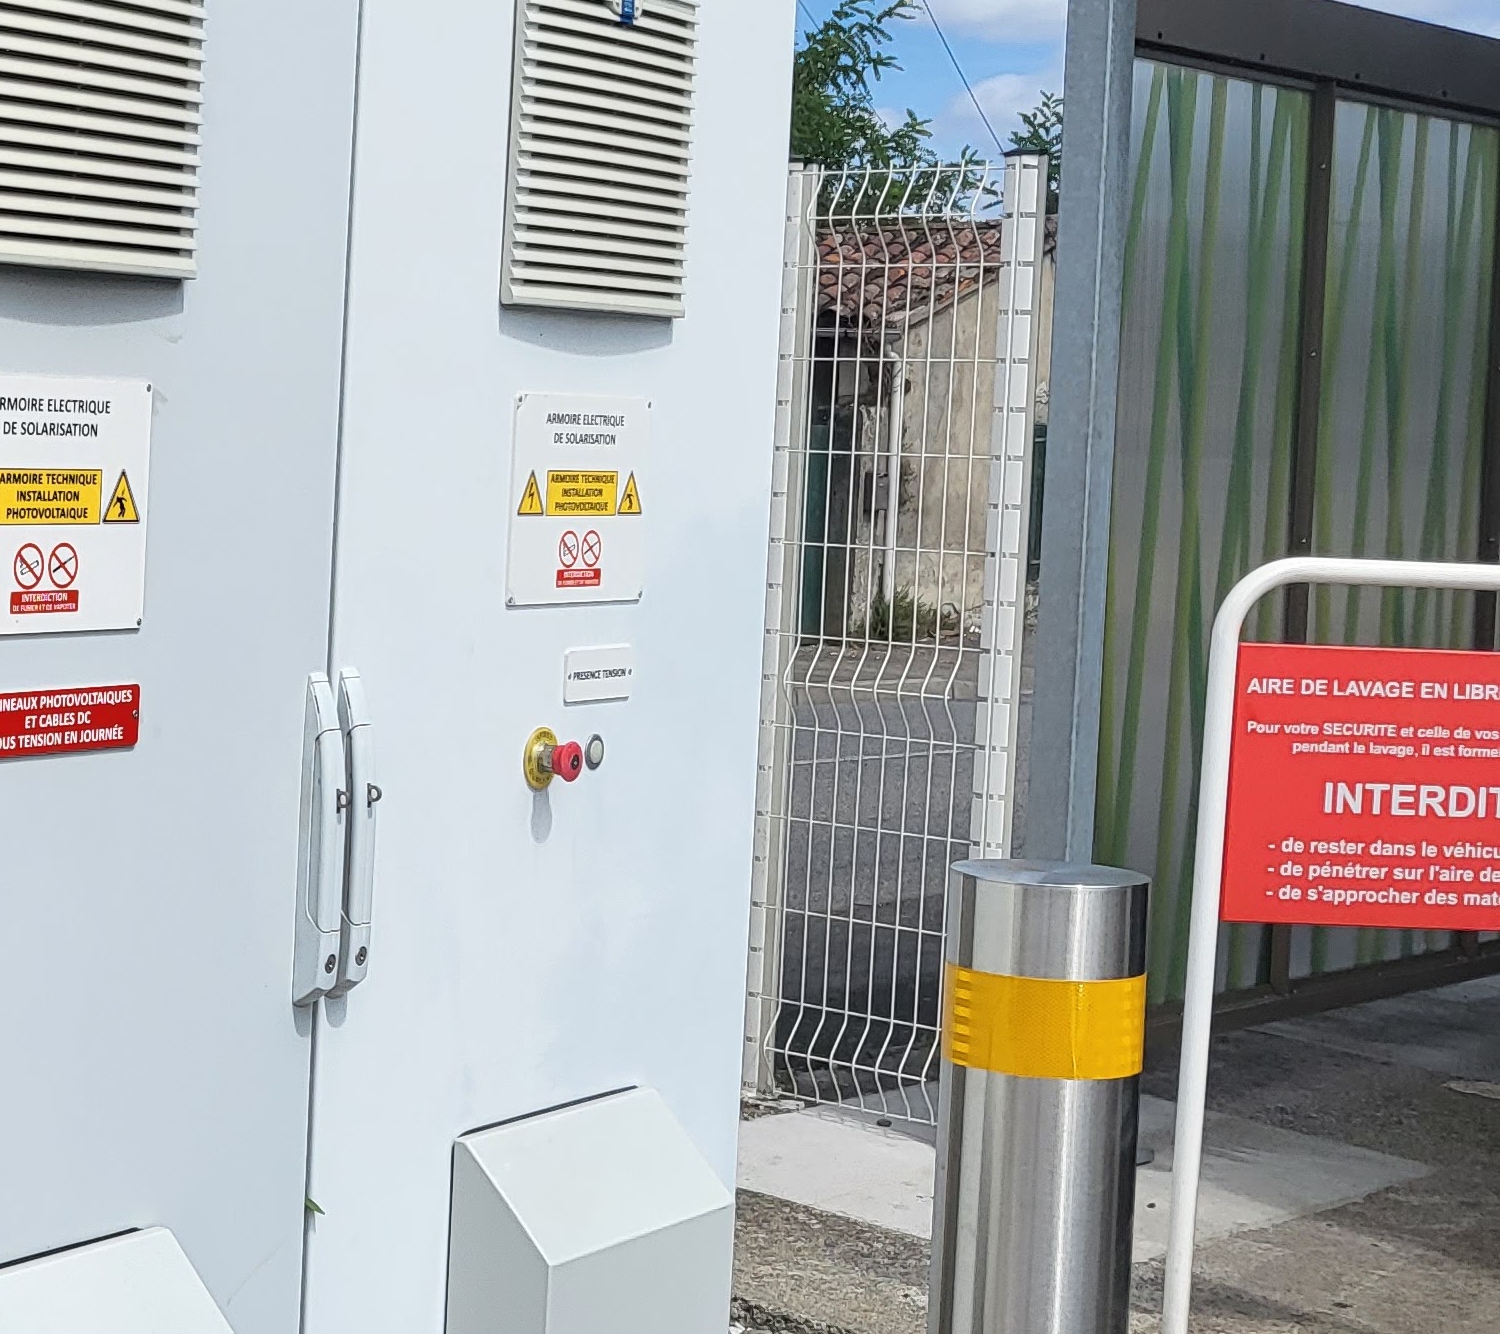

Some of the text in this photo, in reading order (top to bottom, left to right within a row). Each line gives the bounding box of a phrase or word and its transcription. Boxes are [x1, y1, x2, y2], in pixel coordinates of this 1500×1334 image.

[47, 399, 110, 415] ELECTRIQUE
[546, 413, 624, 427] ARMOIRE ELECTRIQUE
[3, 422, 98, 437] DE SOLARISATION
[554, 433, 616, 445] DE SOLARISATION
[0, 473, 97, 486] ARMOIRE TECHNIQUE
[16, 490, 79, 501] INSTALLATION
[6, 508, 88, 519] PHOTOVOLTAIQUE
[22, 593, 68, 602] INTERDICTION
[603, 668, 626, 678] TENSION
[1247, 678, 1500, 700] AIRE DE LAVAGE EN LIBR
[40, 690, 132, 709] PHOTOVOLTAIQUES
[25, 711, 91, 729] ET CABLES DC
[18, 732, 62, 748] TENSION
[65, 731, 78, 744] EN
[79, 724, 124, 743] JOURNÉE
[1247, 721, 1500, 740] Pour votre SECURITE et celle de vos
[1292, 741, 1500, 758] pendant le lavage, il est forme
[1281, 837, 1304, 853] de
[1309, 839, 1365, 855] rester
[1369, 840, 1416, 857] dans
[1421, 842, 1437, 857] le
[1280, 861, 1303, 877] de
[1308, 861, 1388, 880] pénétrer
[1393, 867, 1424, 880] sur
[1429, 865, 1474, 882] l'aire
[1479, 866, 1500, 883] de
[1278, 884, 1301, 900] de
[1307, 885, 1420, 906] s'approcher
[1424, 889, 1458, 905] des
[1463, 892, 1500, 906] mat
